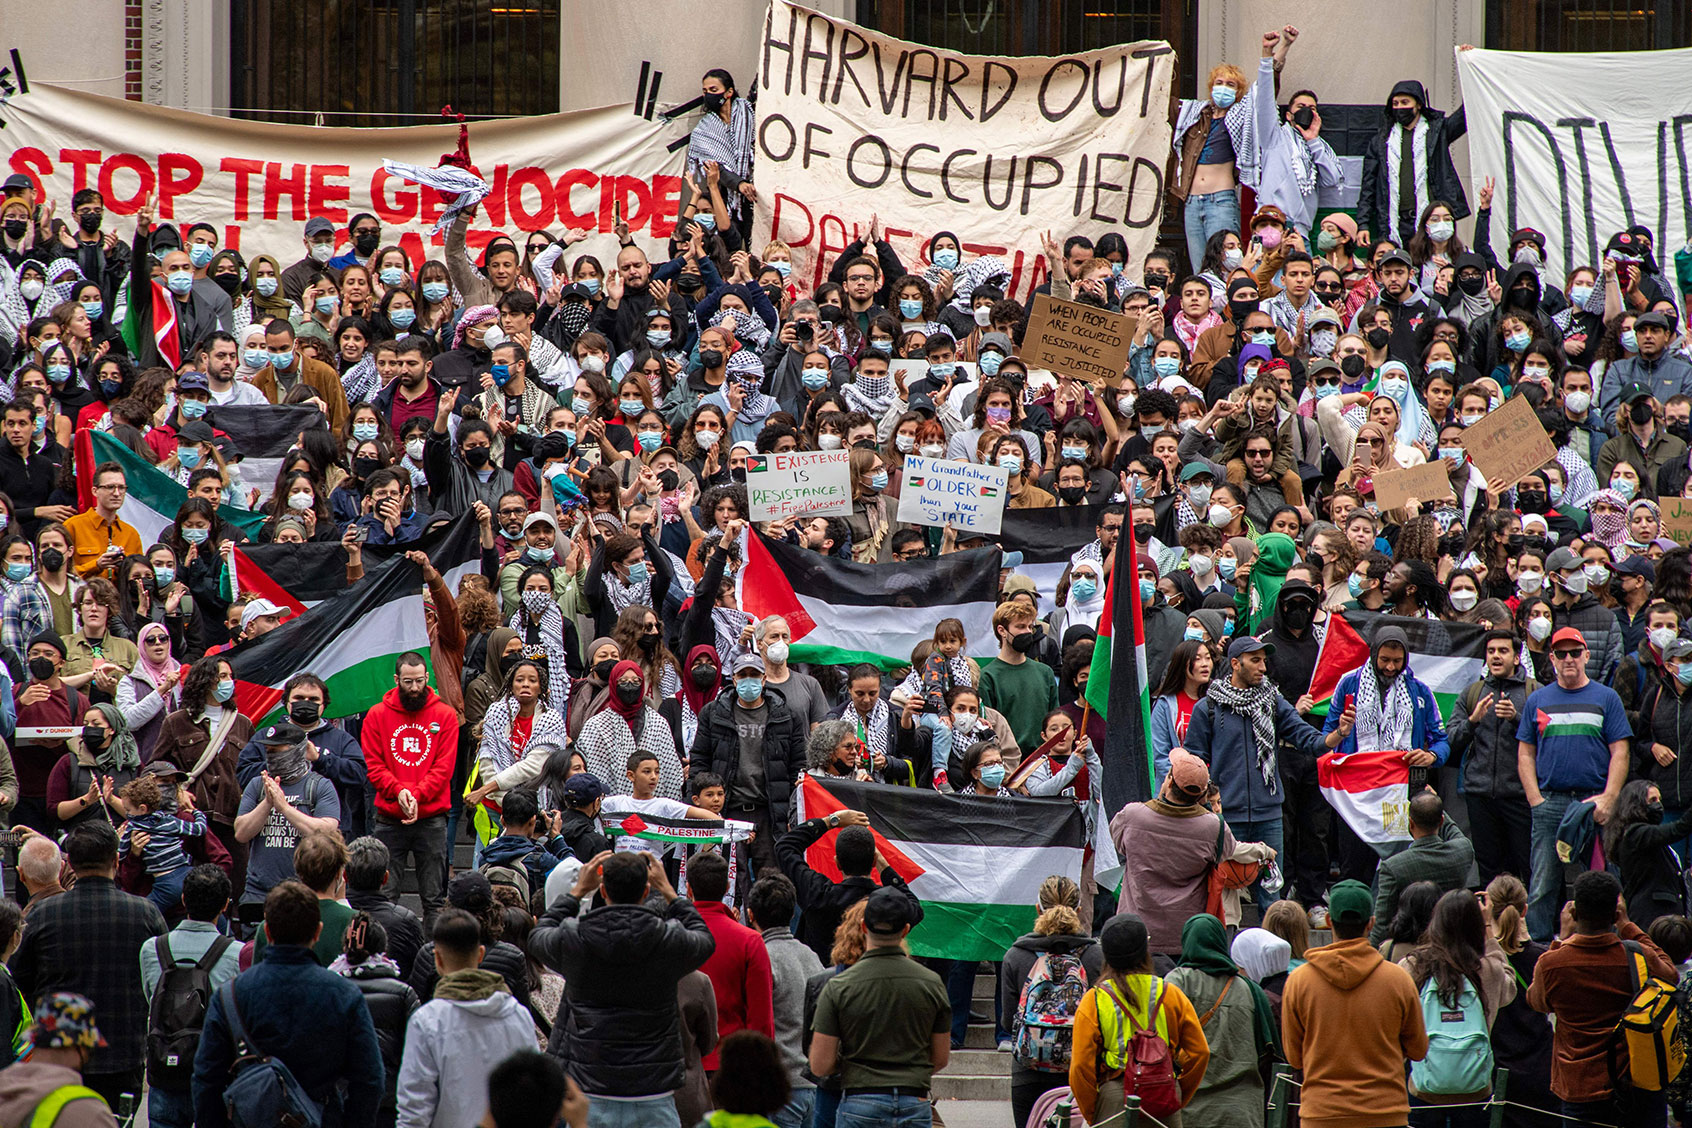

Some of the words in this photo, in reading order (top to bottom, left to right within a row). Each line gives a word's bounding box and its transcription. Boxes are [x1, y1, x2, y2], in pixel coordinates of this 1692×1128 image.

[762, 4, 1018, 123] HARVARD
[1039, 47, 1172, 123] OUT
[759, 114, 832, 168] OF
[847, 135, 1163, 229] OCCUPIED
[1, 147, 204, 219] STOP
[220, 157, 350, 223] THE
[1049, 303, 1079, 320] WHEN
[1082, 311, 1120, 333] PEOPLE
[1046, 318, 1070, 331] ARE
[1071, 325, 1122, 347] OCCUPIED
[1041, 334, 1102, 359] RESISTANCE
[1041, 352, 1056, 364] IS
[1059, 356, 1117, 379] JUSTIFIED
[775, 452, 849, 470] EXISTENCE
[907, 457, 924, 470] MY
[931, 461, 991, 482] Grandfather
[793, 470, 810, 483] IS
[927, 478, 977, 498] OLDER
[766, 499, 846, 515] #FreePalestine
[919, 495, 941, 507] than
[392, 752, 410, 767] PARTY
[260, 825, 287, 837] KNOWS
[265, 836, 282, 848] CAN
[283, 836, 295, 848] BE
[657, 826, 716, 837] PALESTINE
[728, 844, 737, 880] PALES
